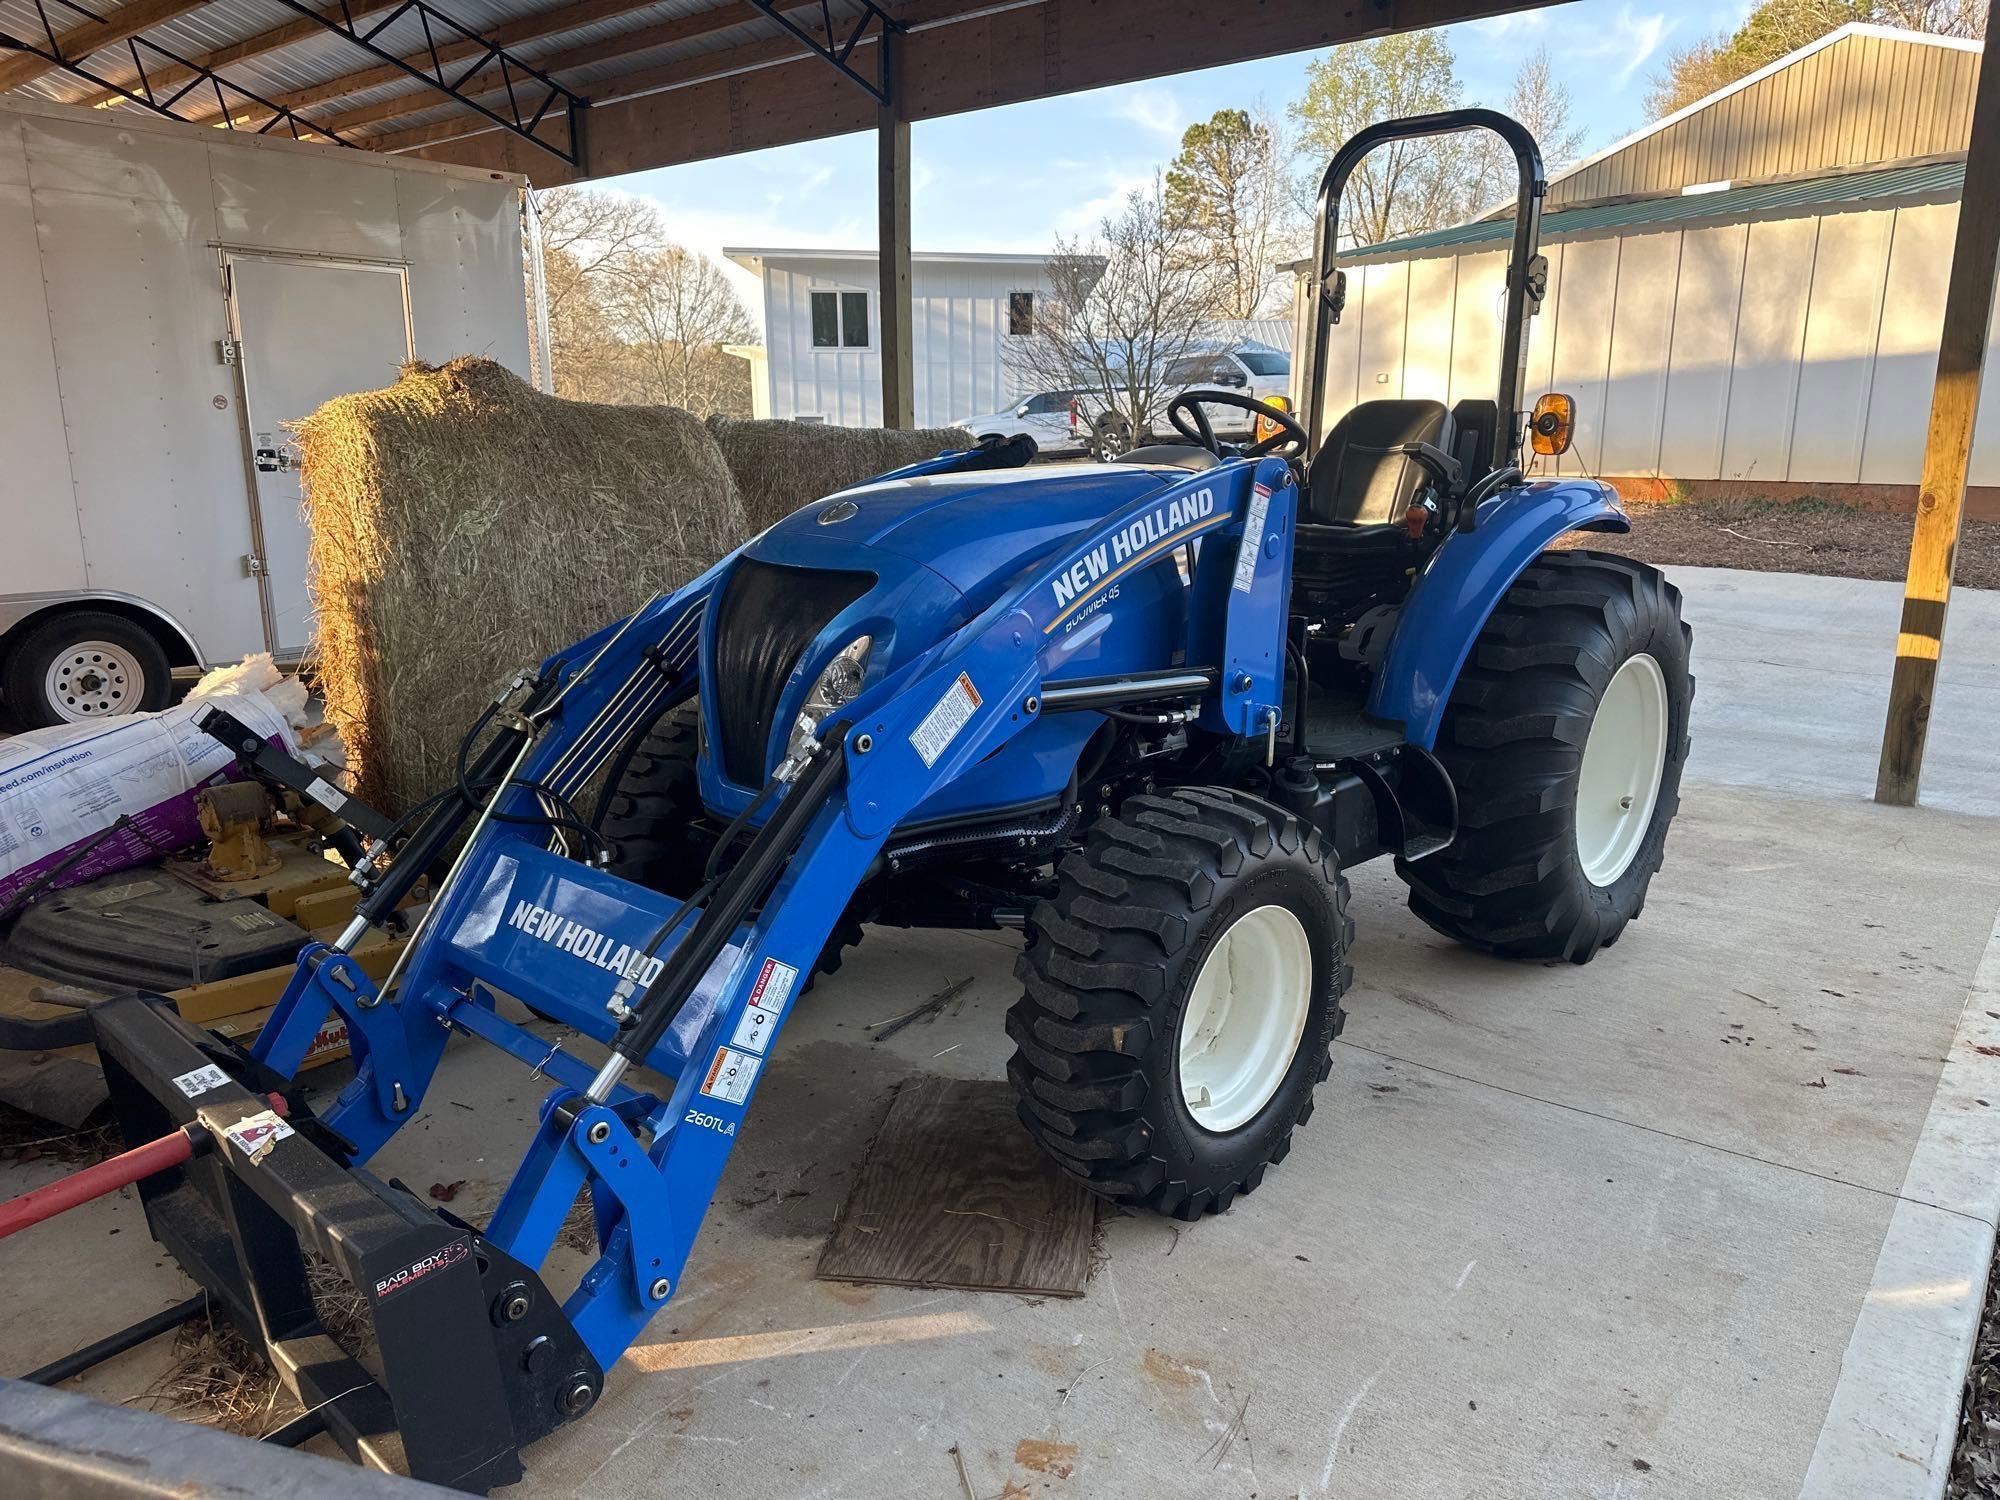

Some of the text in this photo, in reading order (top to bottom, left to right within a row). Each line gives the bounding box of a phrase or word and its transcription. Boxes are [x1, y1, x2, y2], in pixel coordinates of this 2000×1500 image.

[1051, 543, 1109, 609] NEW
[1111, 487, 1214, 564] HOLLAND
[1108, 584, 1120, 600] 45
[0, 750, 93, 794] eed.com/insulation
[508, 900, 565, 943] NEW
[756, 962, 773, 996] DANGER
[709, 1052, 726, 1081] WARNING
[685, 1109, 737, 1137] 260TLA
[376, 1251, 442, 1292] BAD BOY
[377, 1259, 446, 1297] IMPLEMENTS
